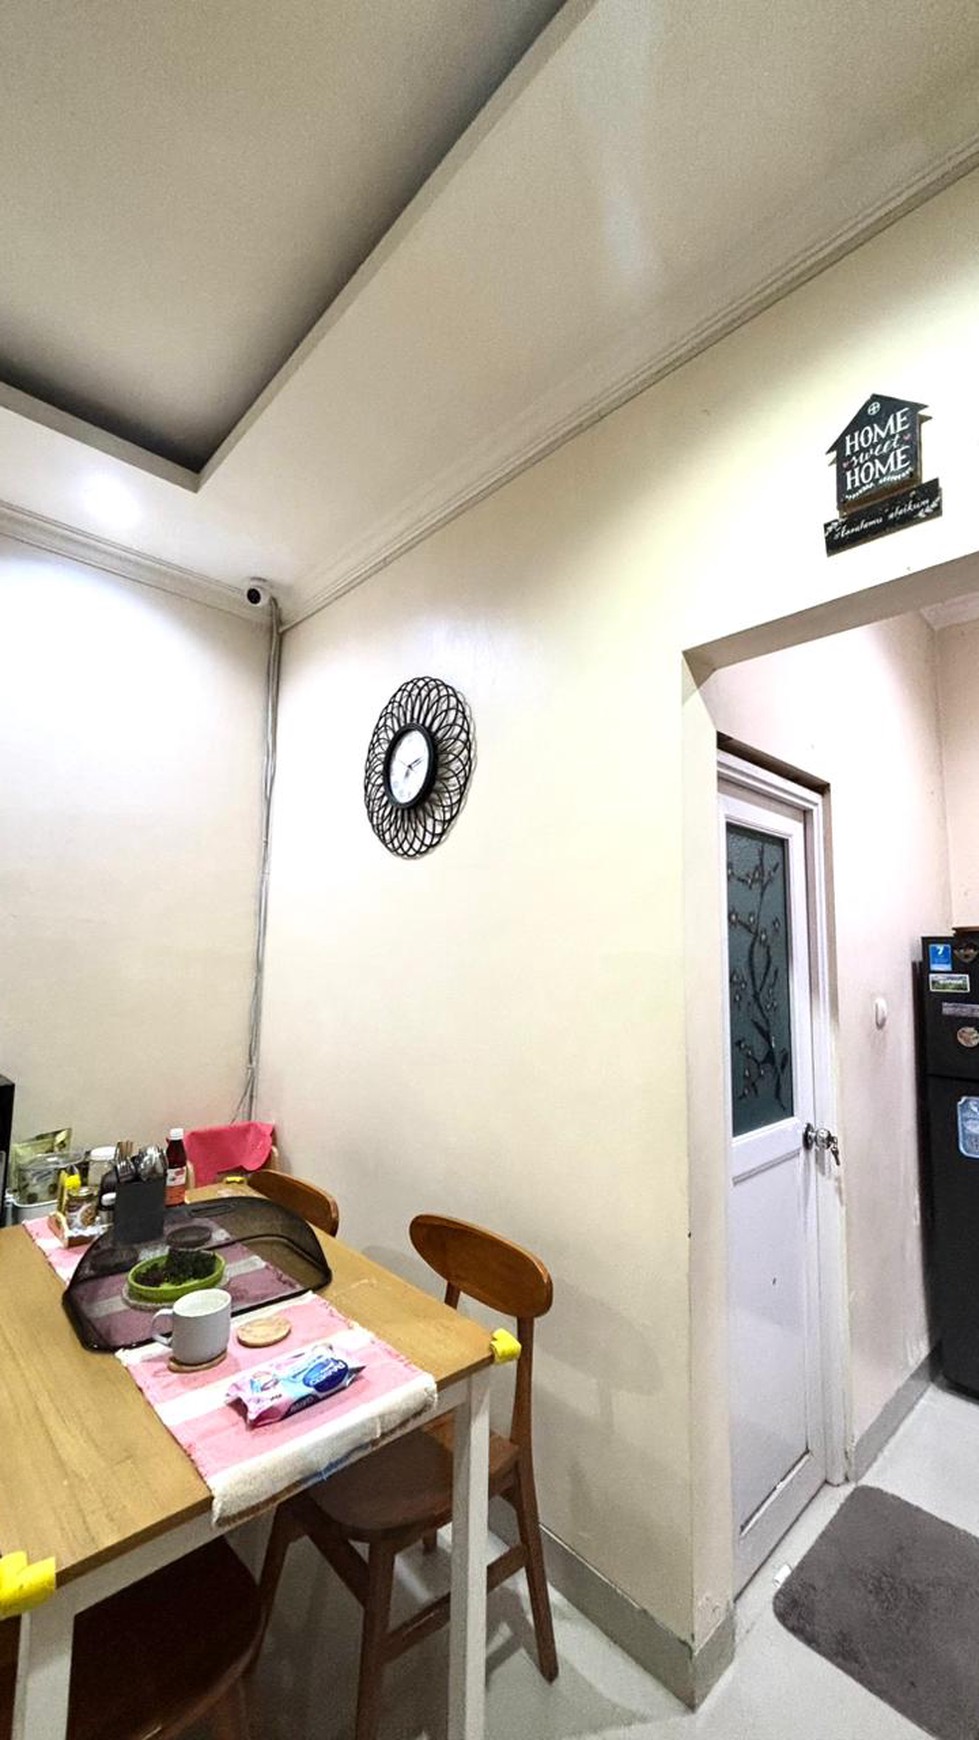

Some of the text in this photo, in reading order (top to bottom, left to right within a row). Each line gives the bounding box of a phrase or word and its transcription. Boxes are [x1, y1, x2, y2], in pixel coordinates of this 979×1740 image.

[845, 408, 910, 455] HOME
[850, 434, 901, 467] sweet
[845, 446, 911, 491] HOME
